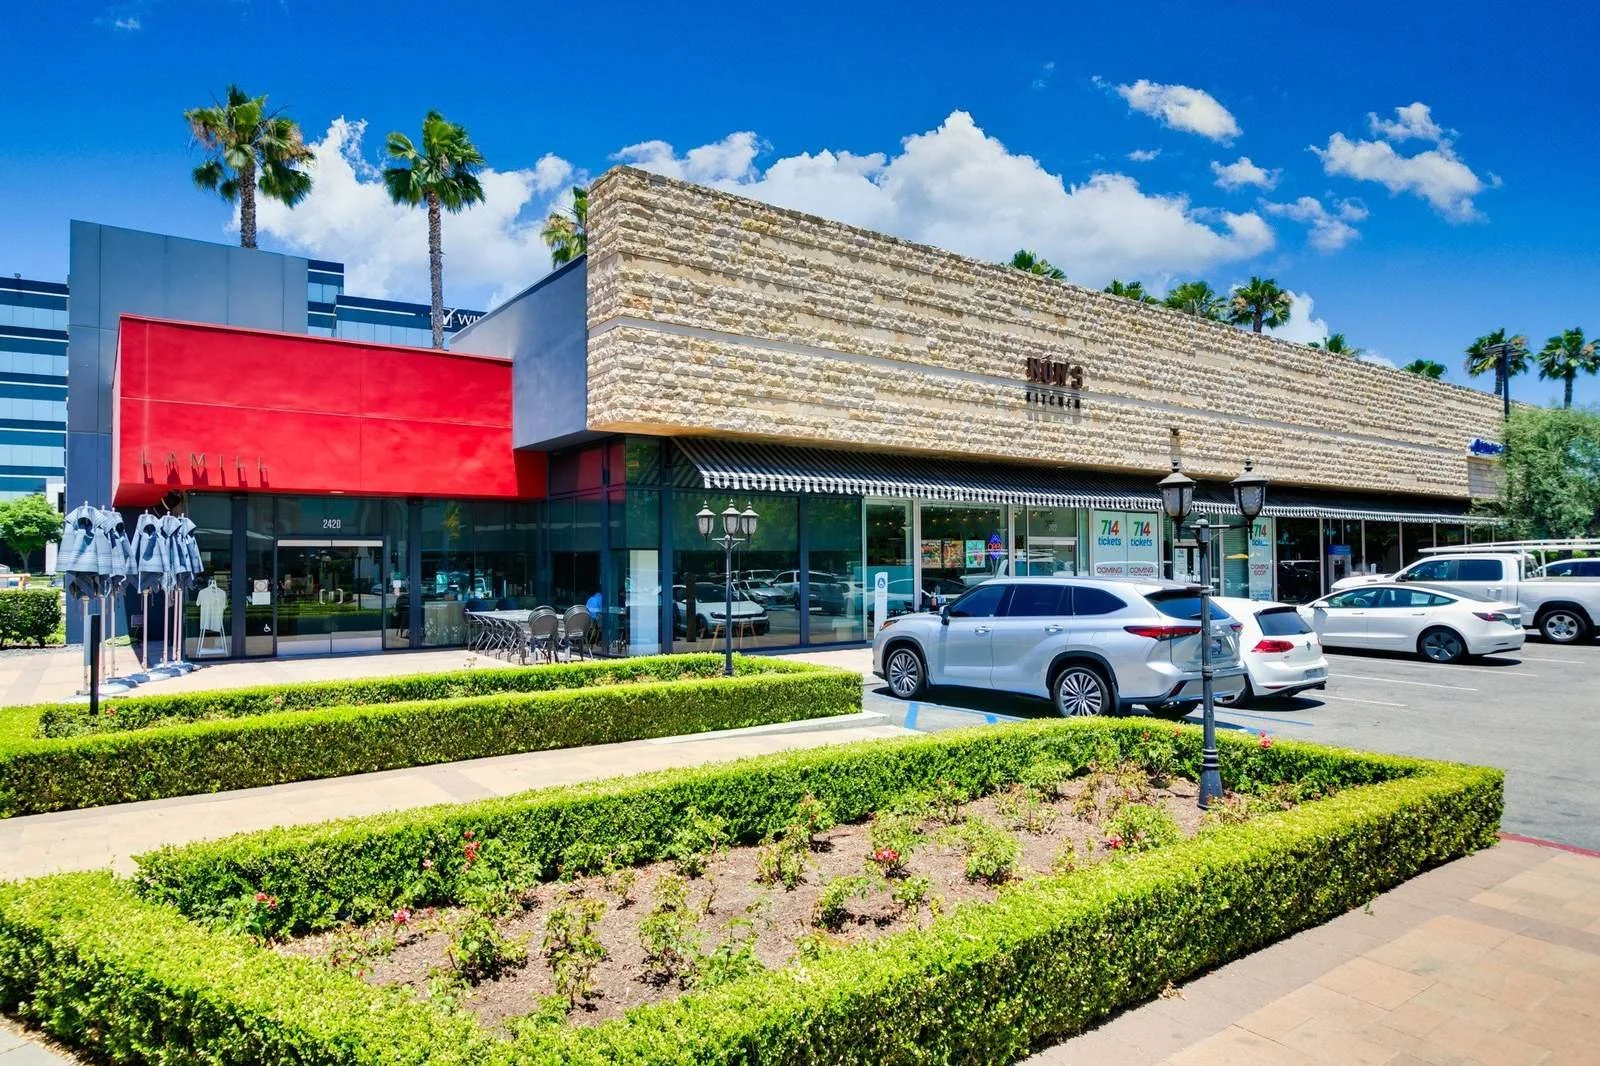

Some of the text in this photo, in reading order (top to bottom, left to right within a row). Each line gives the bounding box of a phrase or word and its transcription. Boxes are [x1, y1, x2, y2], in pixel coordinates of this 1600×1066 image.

[1025, 391, 1080, 409] KITCHEN
[141, 446, 270, 472] LAMILL
[322, 518, 341, 529] 2420
[1101, 519, 1120, 536] 714
[1133, 521, 1151, 536] 714
[1254, 524, 1268, 537] 714
[1098, 536, 1122, 546] tickets
[1130, 538, 1153, 547] tickets
[1096, 566, 1123, 574] COMING
